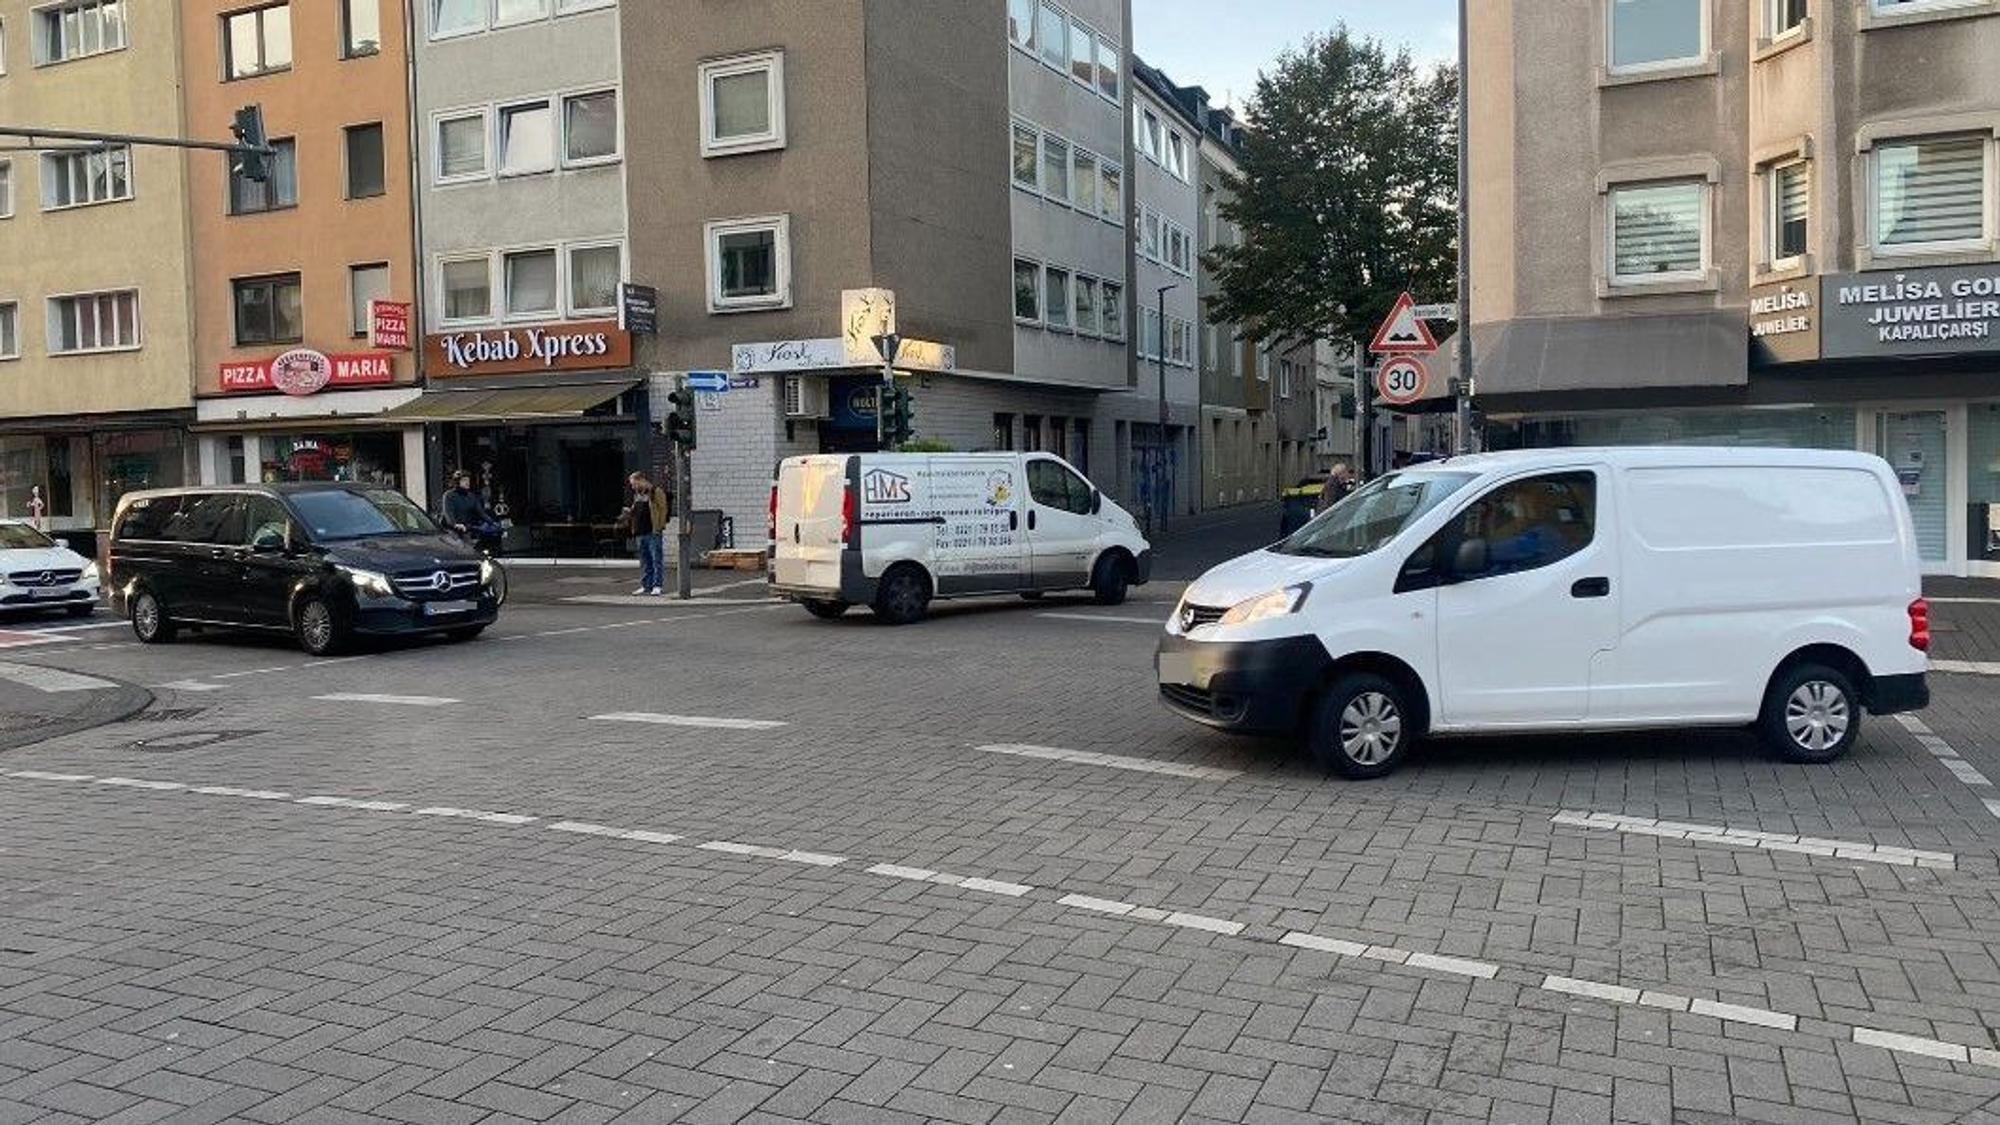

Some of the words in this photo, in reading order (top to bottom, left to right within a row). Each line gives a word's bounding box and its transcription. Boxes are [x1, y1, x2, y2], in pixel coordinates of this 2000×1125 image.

[376, 318, 406, 331] PIZZA
[376, 333, 407, 346] MARIA
[441, 331, 519, 368] Kebab
[524, 327, 607, 366] Xpress
[223, 367, 266, 384] PIZZA
[337, 360, 388, 377] MARIA
[1389, 369, 1416, 390] 30
[865, 475, 910, 503] HMS
